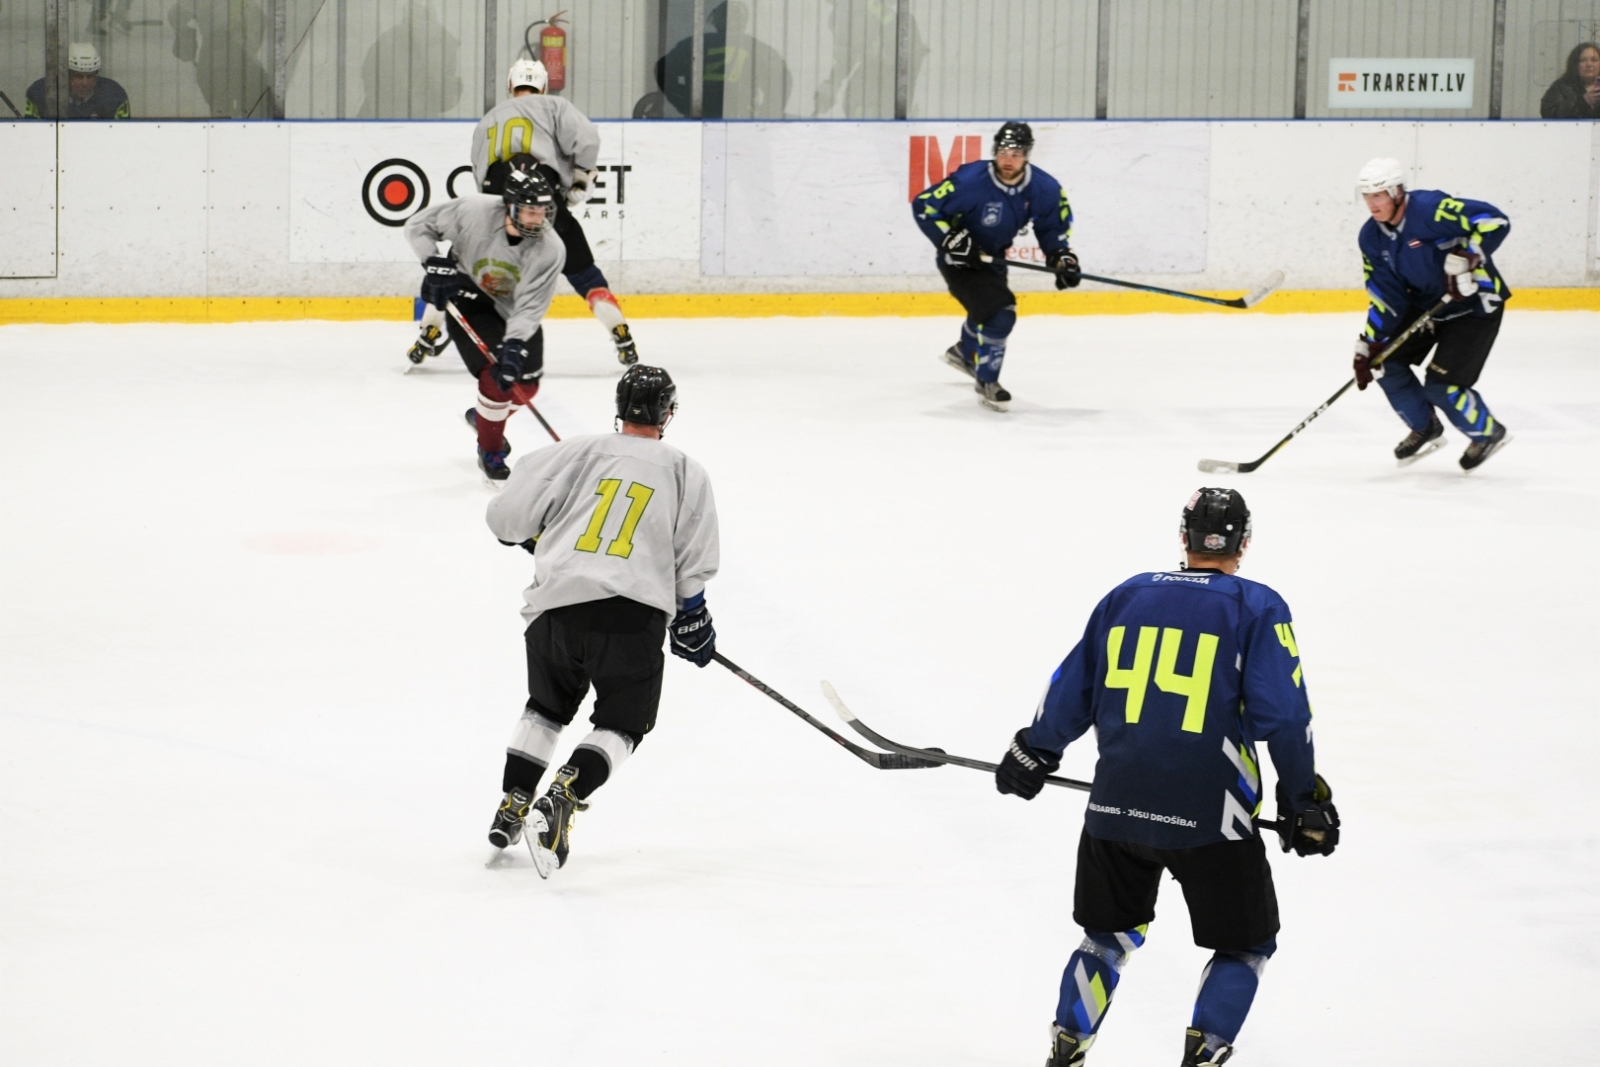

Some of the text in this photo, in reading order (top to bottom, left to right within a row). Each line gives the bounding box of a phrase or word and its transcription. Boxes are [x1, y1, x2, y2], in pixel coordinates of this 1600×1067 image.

[1362, 73, 1465, 92] TRARENT.LV
[487, 117, 533, 166] 10
[1434, 198, 1465, 222] 73
[574, 478, 654, 559] 11
[1162, 575, 1210, 584] POLICIJA
[1105, 625, 1219, 733] 44
